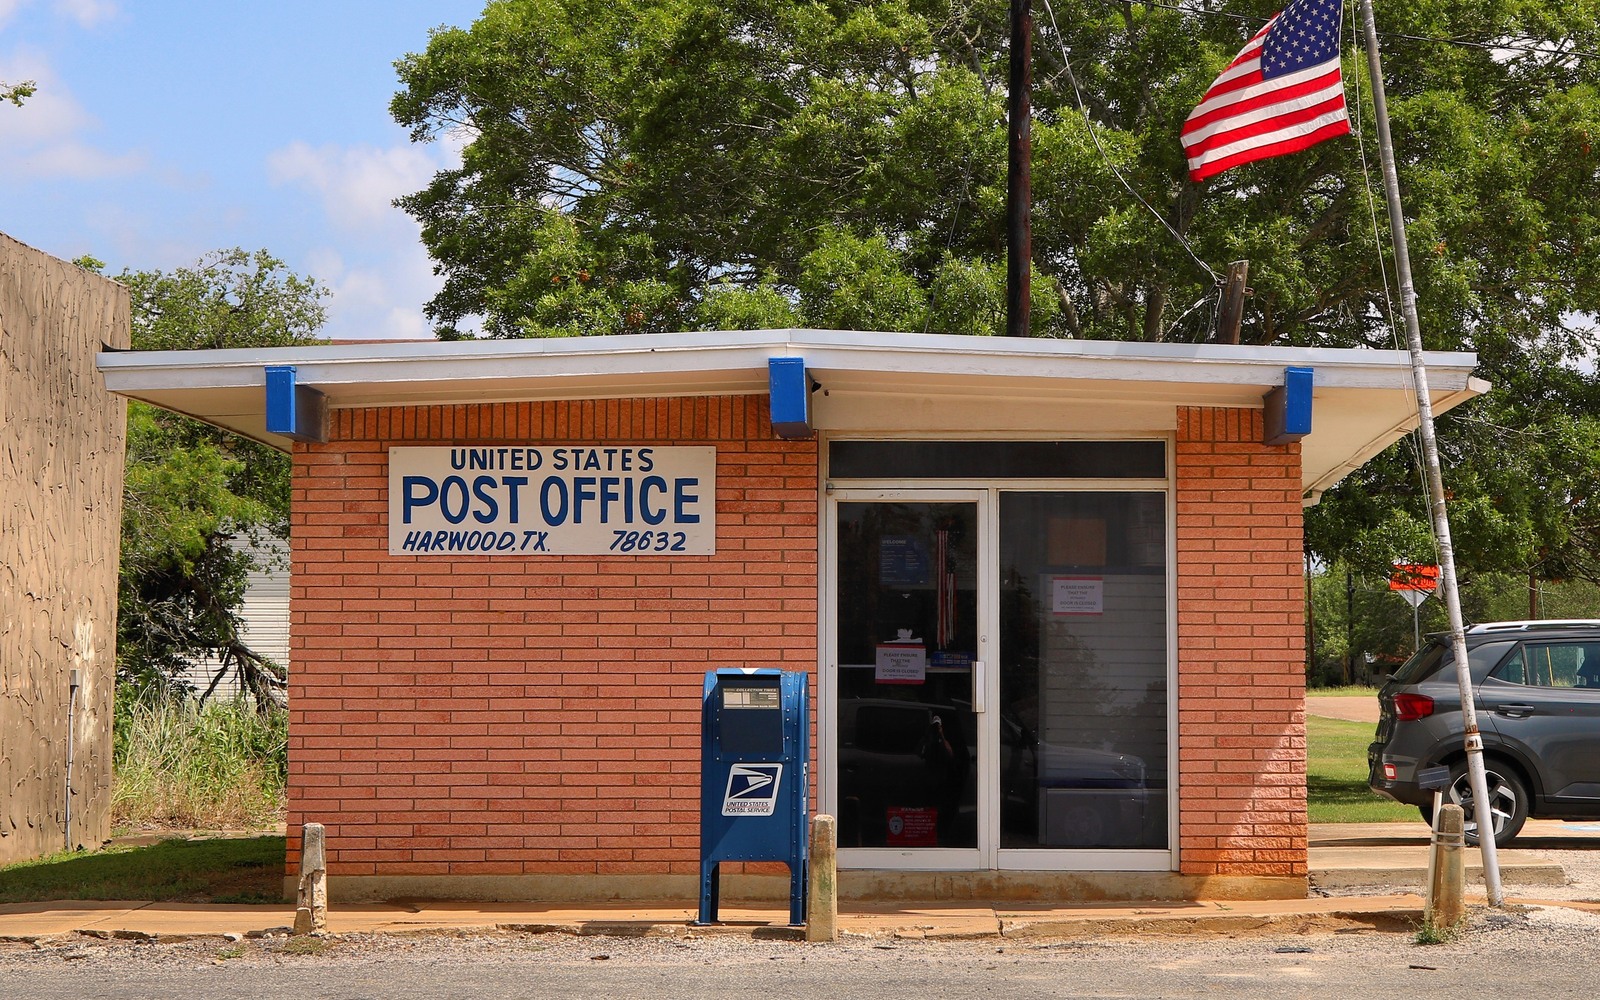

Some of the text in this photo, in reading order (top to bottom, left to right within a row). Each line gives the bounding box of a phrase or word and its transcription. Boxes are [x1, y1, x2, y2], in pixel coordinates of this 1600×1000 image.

[451, 448, 654, 472] UNITED STATES
[402, 475, 701, 527] POST OFFICE
[609, 530, 687, 552] 78632
